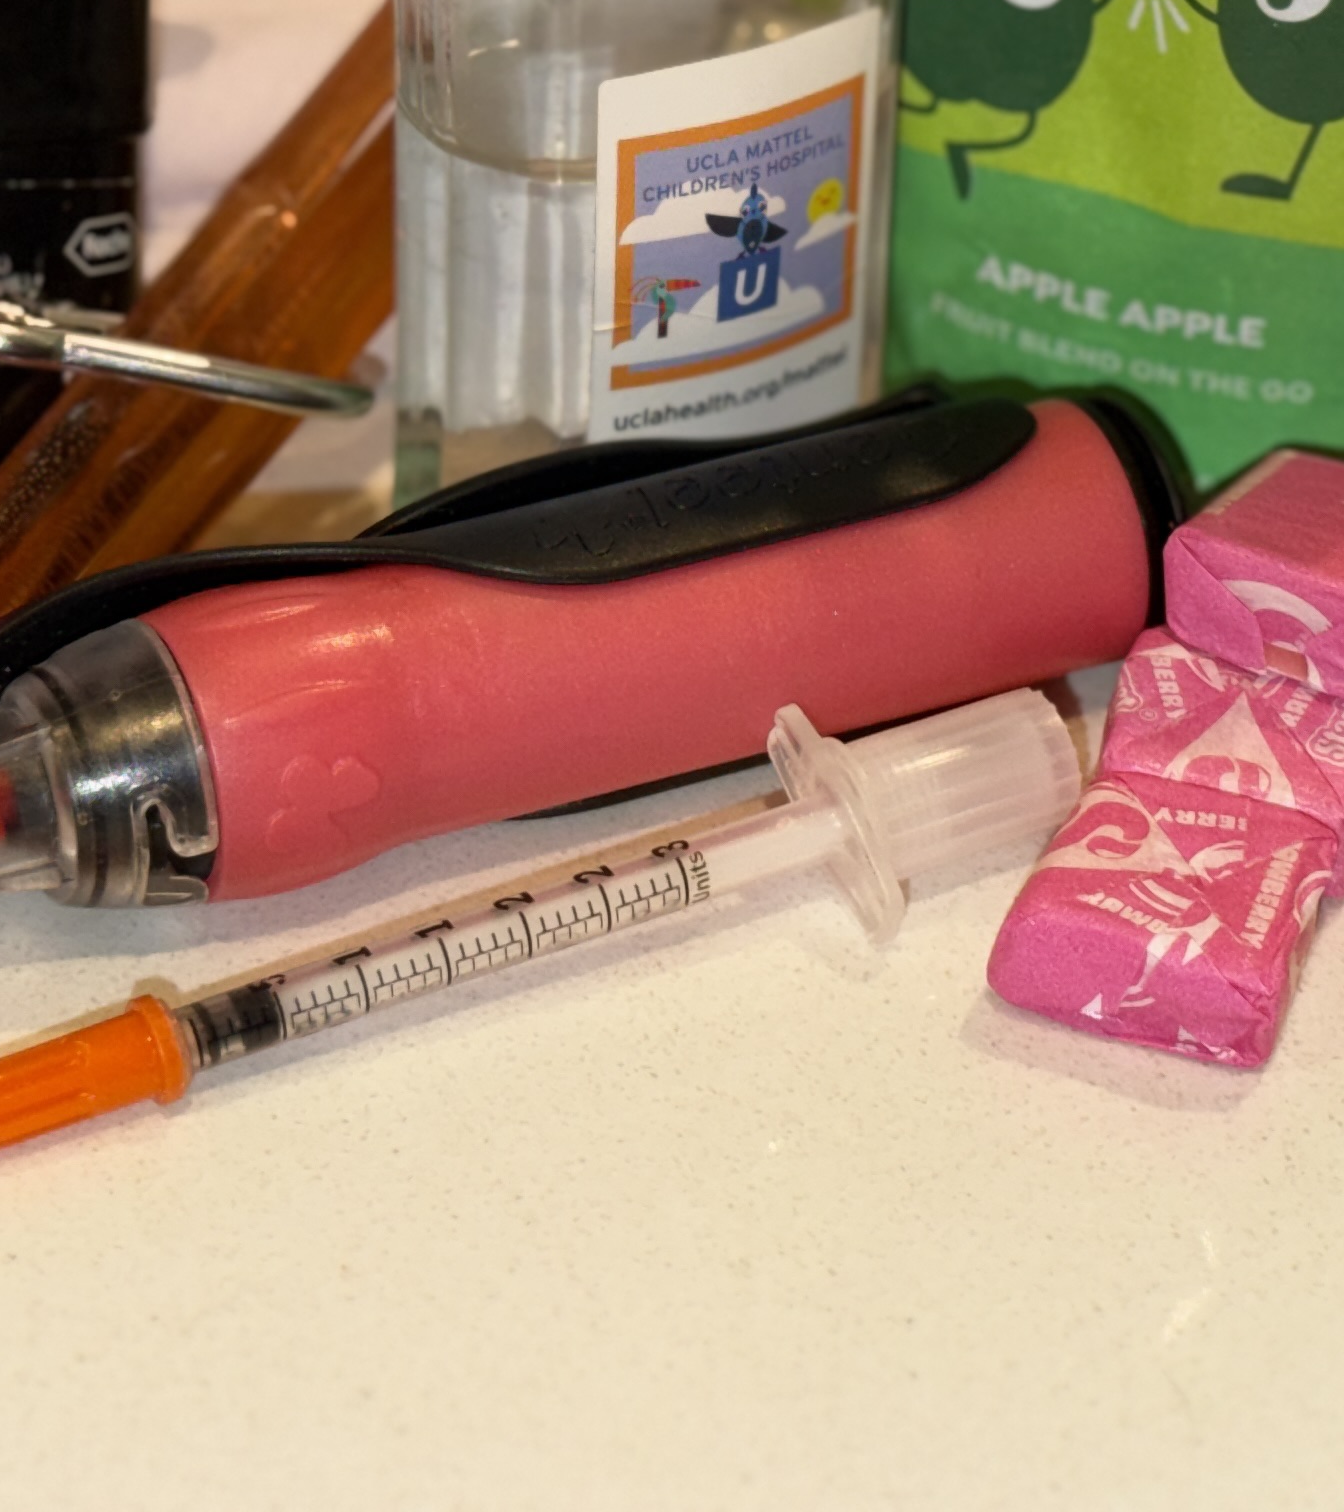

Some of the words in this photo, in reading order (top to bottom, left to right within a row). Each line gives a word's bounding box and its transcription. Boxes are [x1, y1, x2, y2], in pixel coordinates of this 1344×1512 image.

[643, 167, 761, 204] CHILDREN'S
[767, 132, 846, 178] HOSPITAL
[687, 148, 739, 174] UCLA
[746, 126, 814, 161] MATTEL
[735, 263, 767, 307] U
[976, 256, 1111, 320] APPLE
[1120, 300, 1267, 349] APPLE
[931, 293, 1012, 344] FRUIT
[1017, 330, 1122, 376] BLEND
[1129, 358, 1181, 388] ON
[1188, 369, 1252, 399] THE
[1259, 380, 1316, 405] GO
[689, 850, 711, 904] Units
